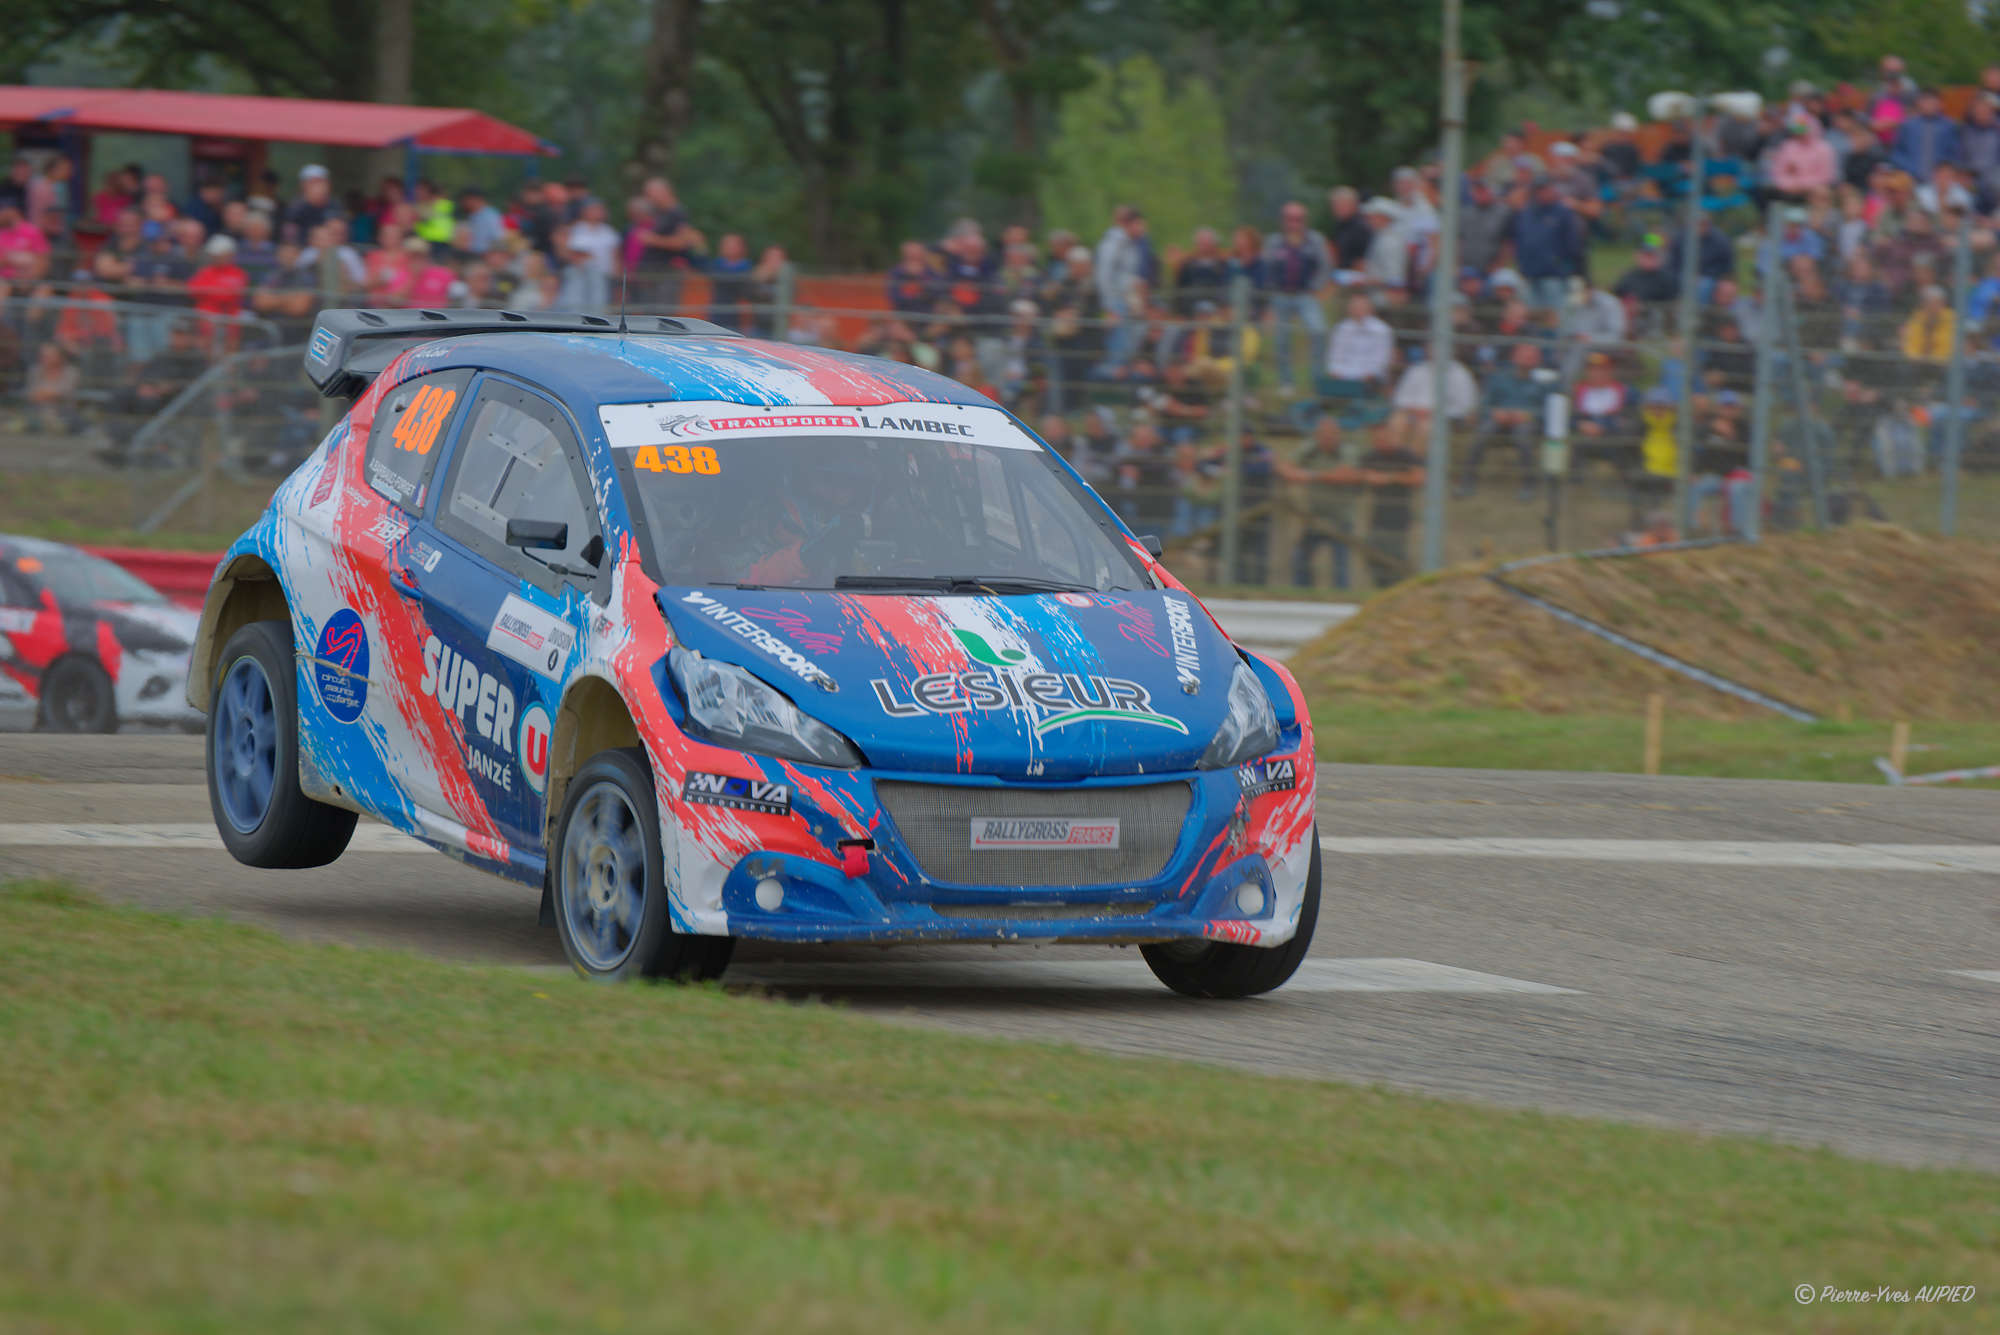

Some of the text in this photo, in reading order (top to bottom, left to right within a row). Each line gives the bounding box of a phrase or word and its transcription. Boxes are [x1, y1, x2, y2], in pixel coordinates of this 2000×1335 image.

[392, 384, 456, 455] 438
[713, 416, 974, 437] TRANSPORTS LAMBEC
[634, 445, 721, 475] 438
[1163, 595, 1201, 671] INTERSPORT
[420, 634, 516, 754] SUPER
[869, 671, 1157, 718] LESIEUR
[467, 744, 513, 793] JANZÉ
[526, 725, 549, 777] U
[984, 821, 1070, 840] RALLYCROSS
